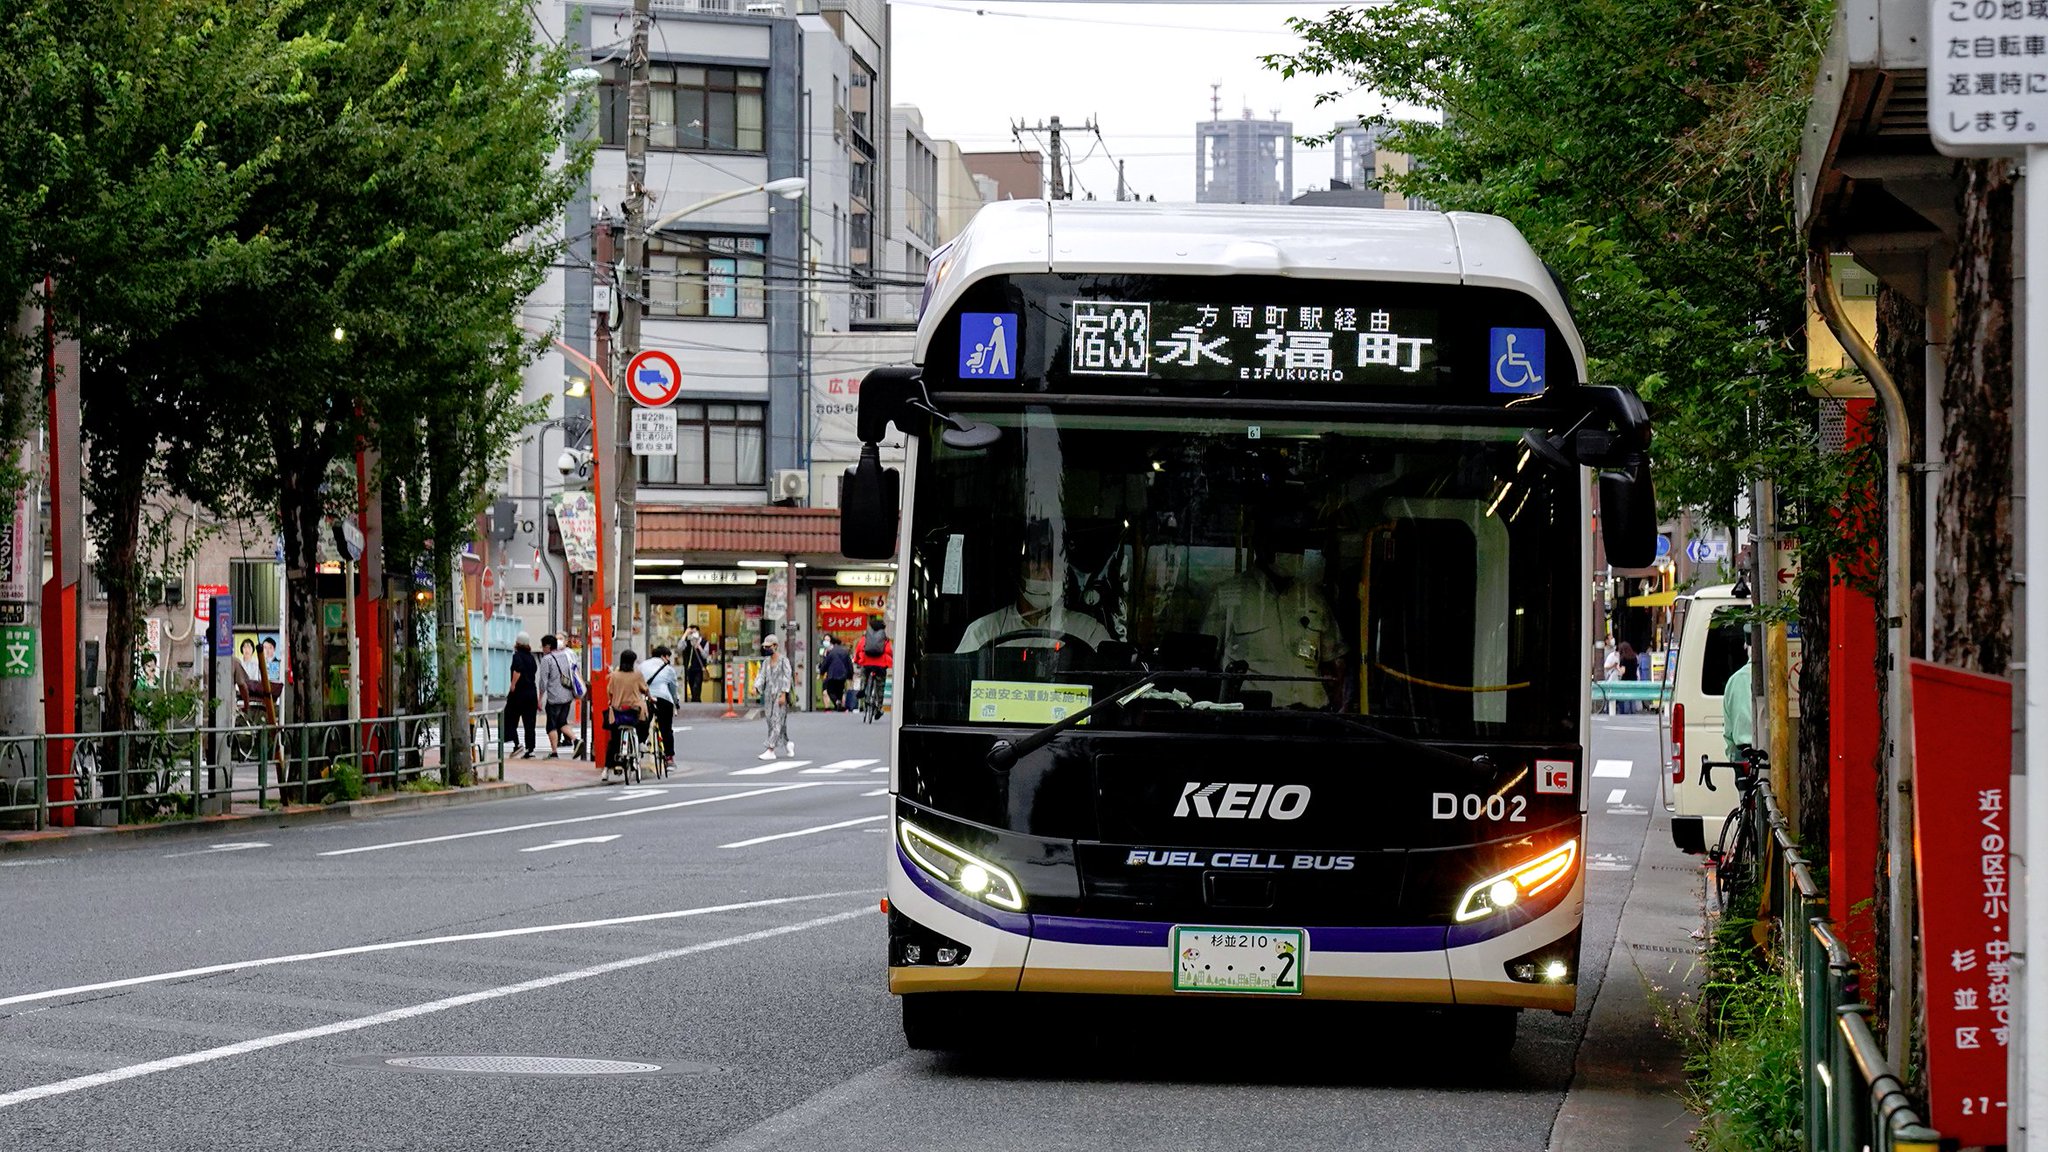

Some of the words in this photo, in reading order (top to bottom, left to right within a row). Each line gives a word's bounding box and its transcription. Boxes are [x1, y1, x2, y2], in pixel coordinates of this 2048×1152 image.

[1947, 34, 2047, 59] た自転車
[1947, 72, 2048, 96] 返還時に
[1949, 107, 2036, 133] します。
[1196, 303, 1390, 332] 方南町駅経由
[1075, 307, 1147, 369] 宿33
[1154, 325, 1433, 373] 永福町
[1239, 366, 1345, 382] EIFUKUCHO
[818, 594, 852, 610] 宝くじ
[5, 641, 29, 668] 文
[972, 686, 1088, 704] 交通安全運動実施中
[1173, 781, 1312, 821] KEIO
[1432, 791, 1528, 823] D002
[1126, 850, 1206, 867] FUEL
[1210, 852, 1285, 869] CELL
[1291, 854, 1356, 871] BUS
[1977, 788, 2011, 1047] 近くの区立小・中学校です
[1951, 948, 1980, 1050] 杉並区
